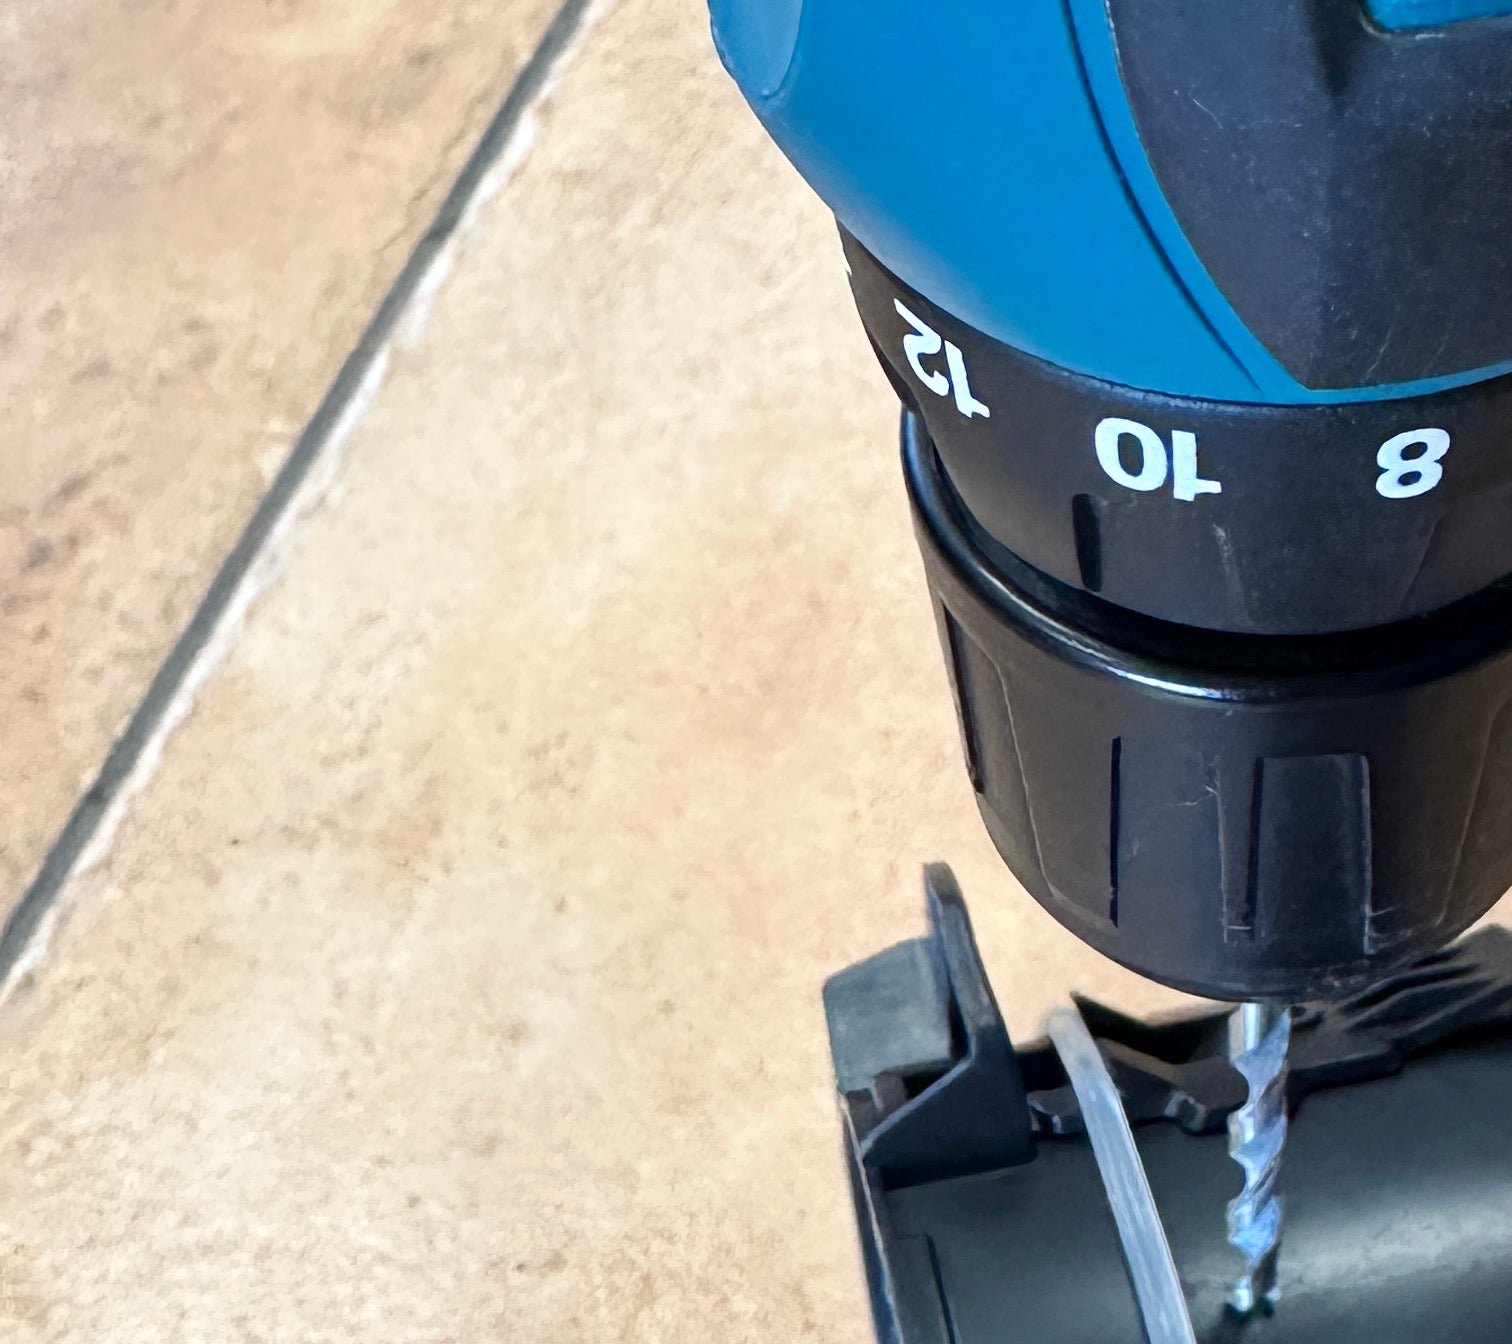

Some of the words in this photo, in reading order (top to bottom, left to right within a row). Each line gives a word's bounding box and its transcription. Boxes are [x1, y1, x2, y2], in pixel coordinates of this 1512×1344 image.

[893, 297, 991, 419] 12
[1094, 416, 1222, 502] 10
[1375, 427, 1451, 499] 8
